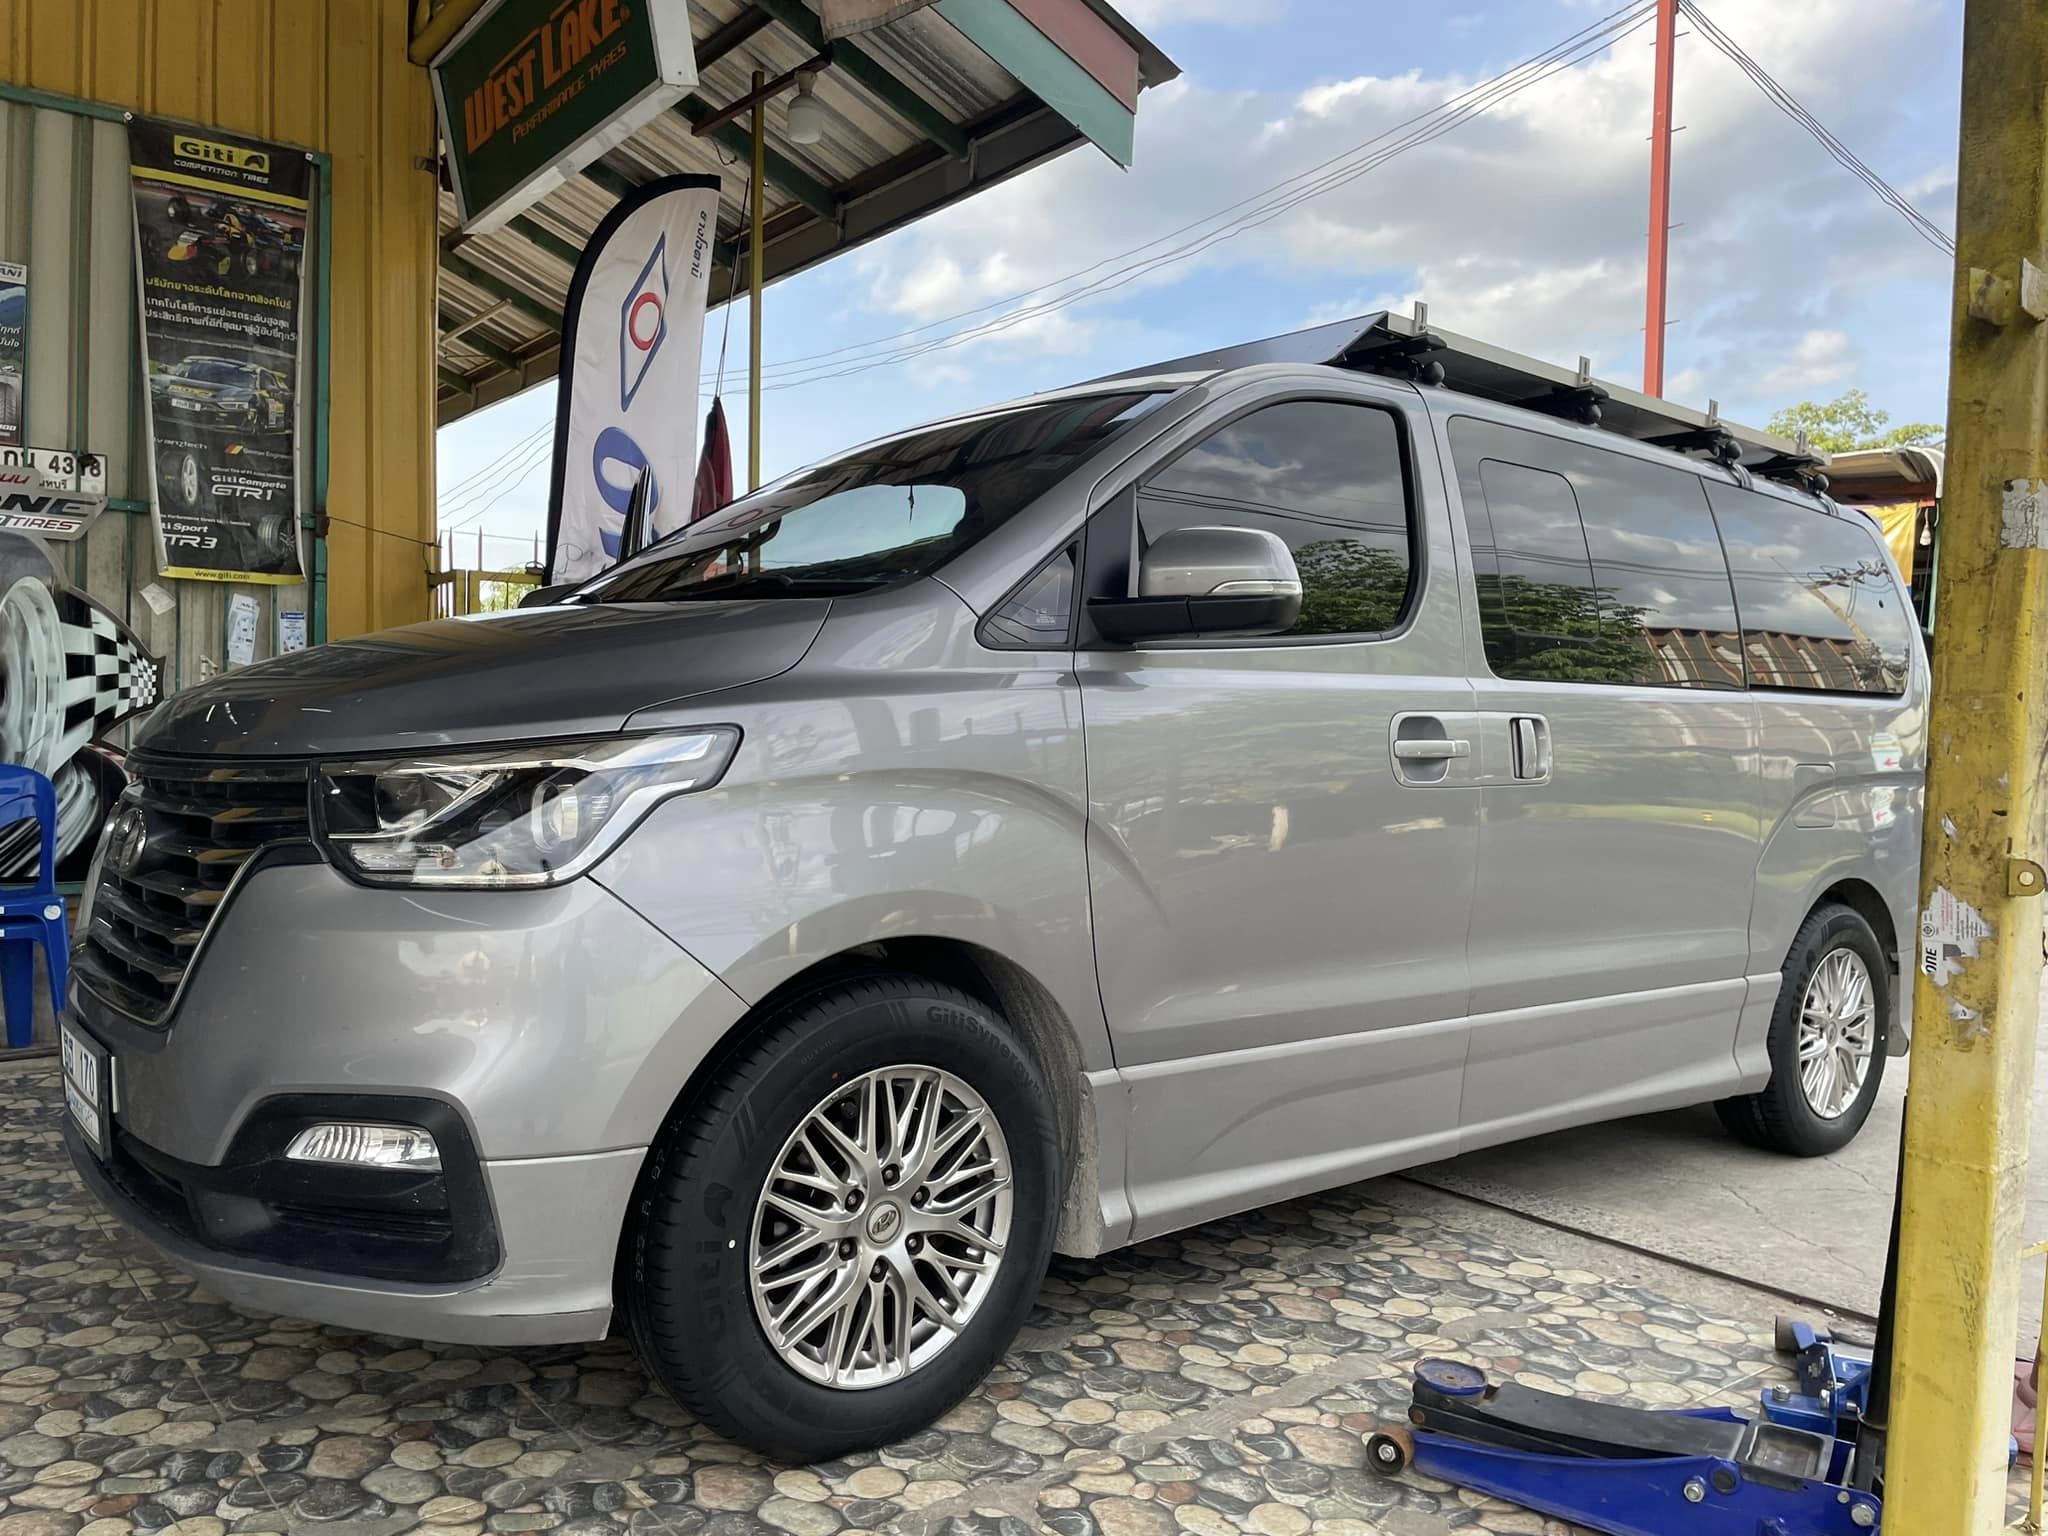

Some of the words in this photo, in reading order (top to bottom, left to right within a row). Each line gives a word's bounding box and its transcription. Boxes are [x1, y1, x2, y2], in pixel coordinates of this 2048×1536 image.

[588, 40, 628, 82] TYRES
[464, 47, 536, 155] WEST
[179, 140, 235, 163] Giti
[242, 171, 270, 185] TIRES
[211, 474, 238, 485] Giti
[238, 477, 287, 490] Compete
[211, 484, 273, 501] GTR1
[0, 494, 97, 517] NE
[10, 515, 82, 531] TIRES
[172, 522, 209, 533] Sport
